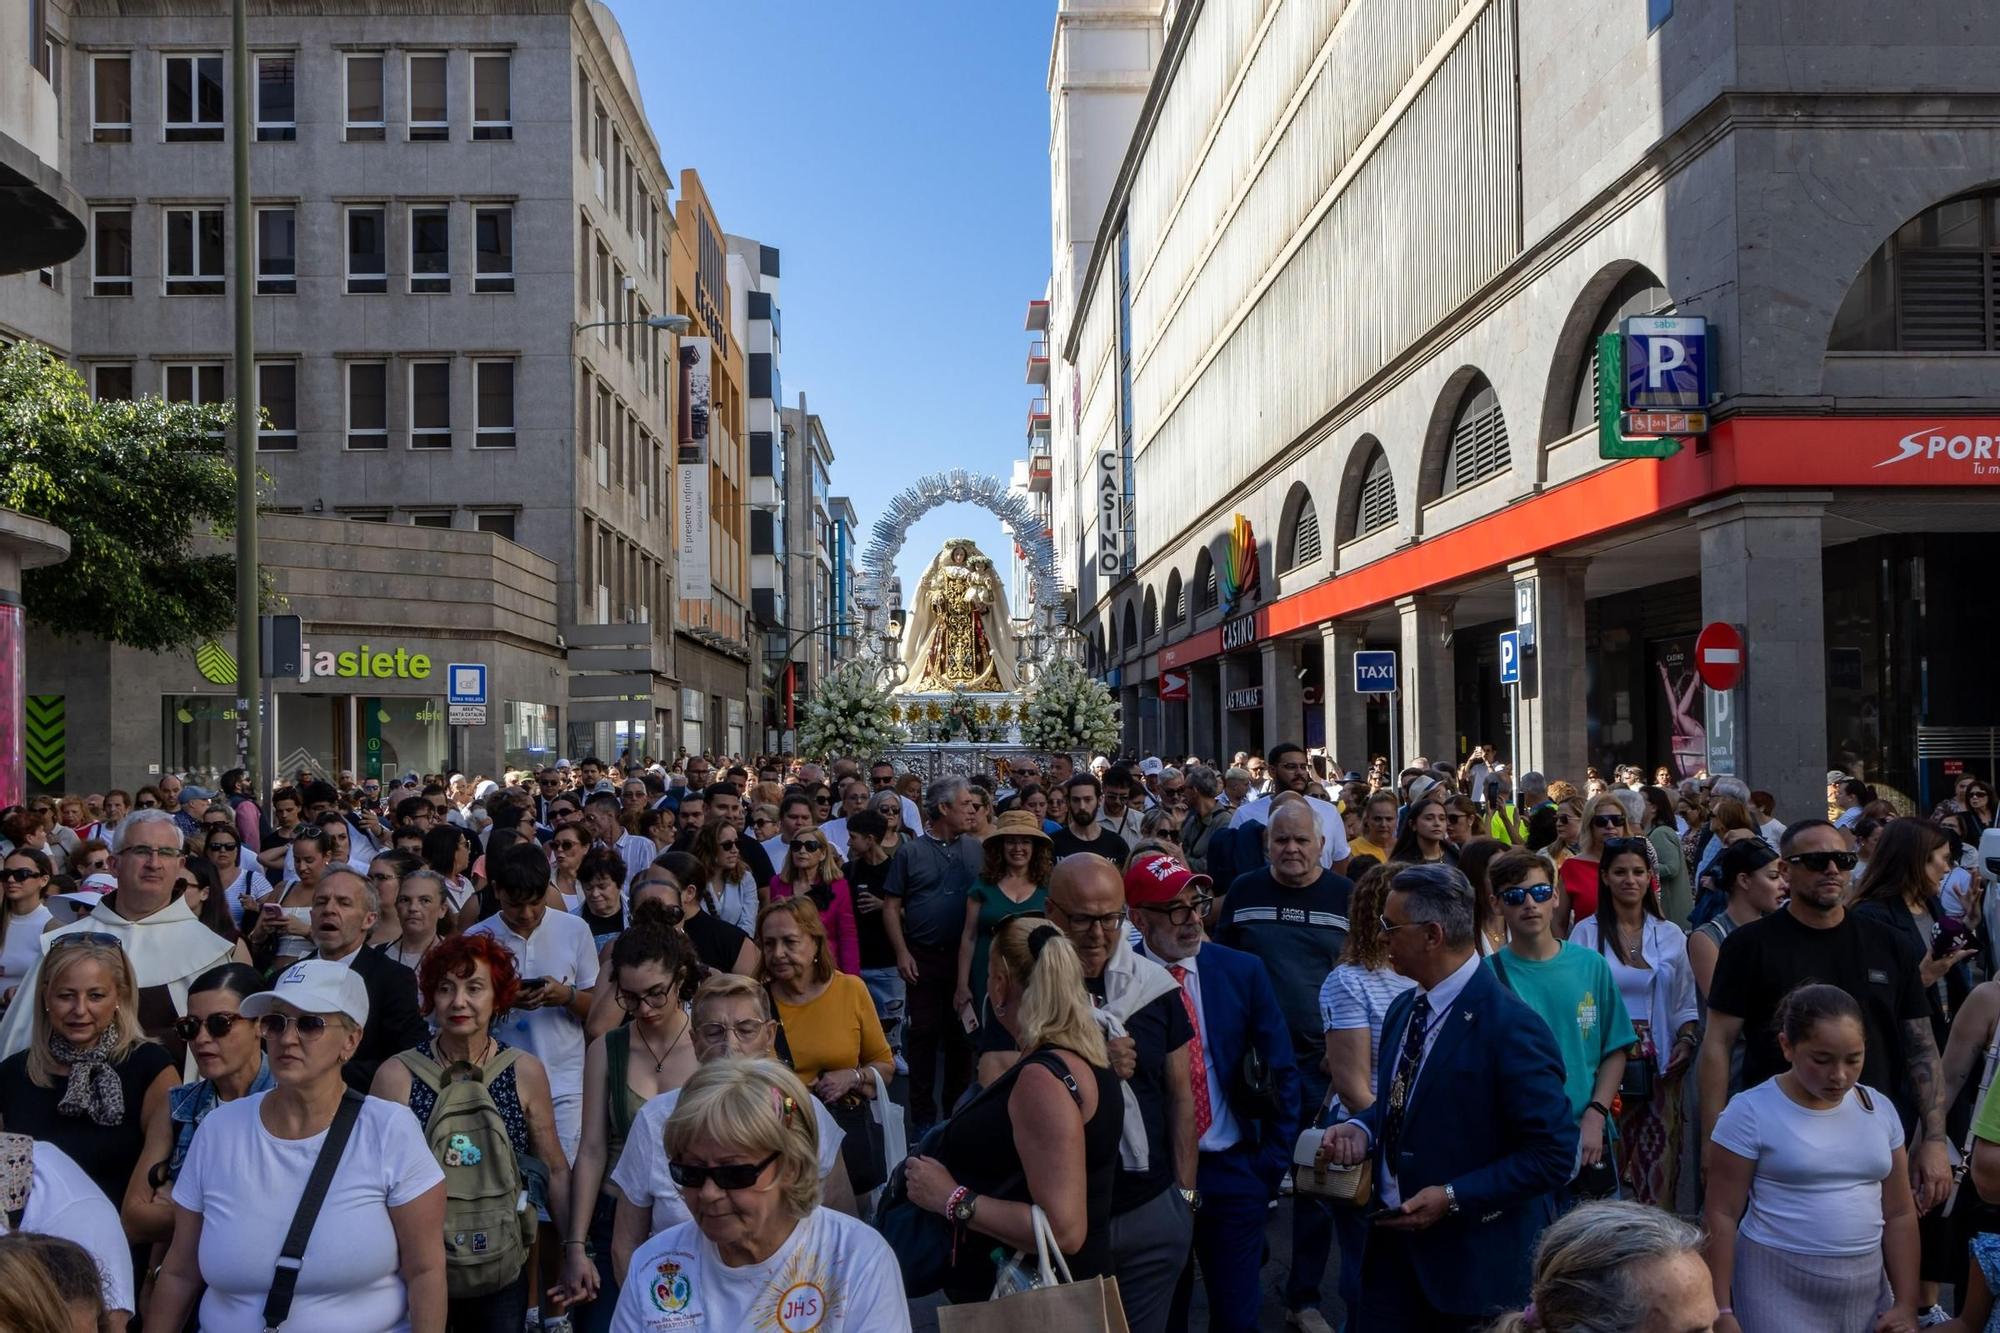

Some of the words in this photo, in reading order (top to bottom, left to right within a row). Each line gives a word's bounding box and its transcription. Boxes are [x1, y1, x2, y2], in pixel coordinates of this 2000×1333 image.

[1654, 319, 1677, 329] saba
[1648, 337, 1686, 388] P
[1973, 462, 1985, 474] Tu
[1988, 466, 2000, 474] m
[683, 470, 693, 502] infinito
[683, 505, 694, 543] presente
[1100, 453, 1119, 571] CASINO
[684, 546, 693, 554] El
[1222, 615, 1254, 650] CASINO
[299, 643, 432, 684] jasiete
[1358, 666, 1393, 679] TAXI
[1502, 640, 1513, 676] P
[1225, 692, 1235, 710] LAS
[1235, 688, 1258, 708] PALMAS
[1714, 690, 1729, 738] P
[783, 1298, 817, 1320] JHS
